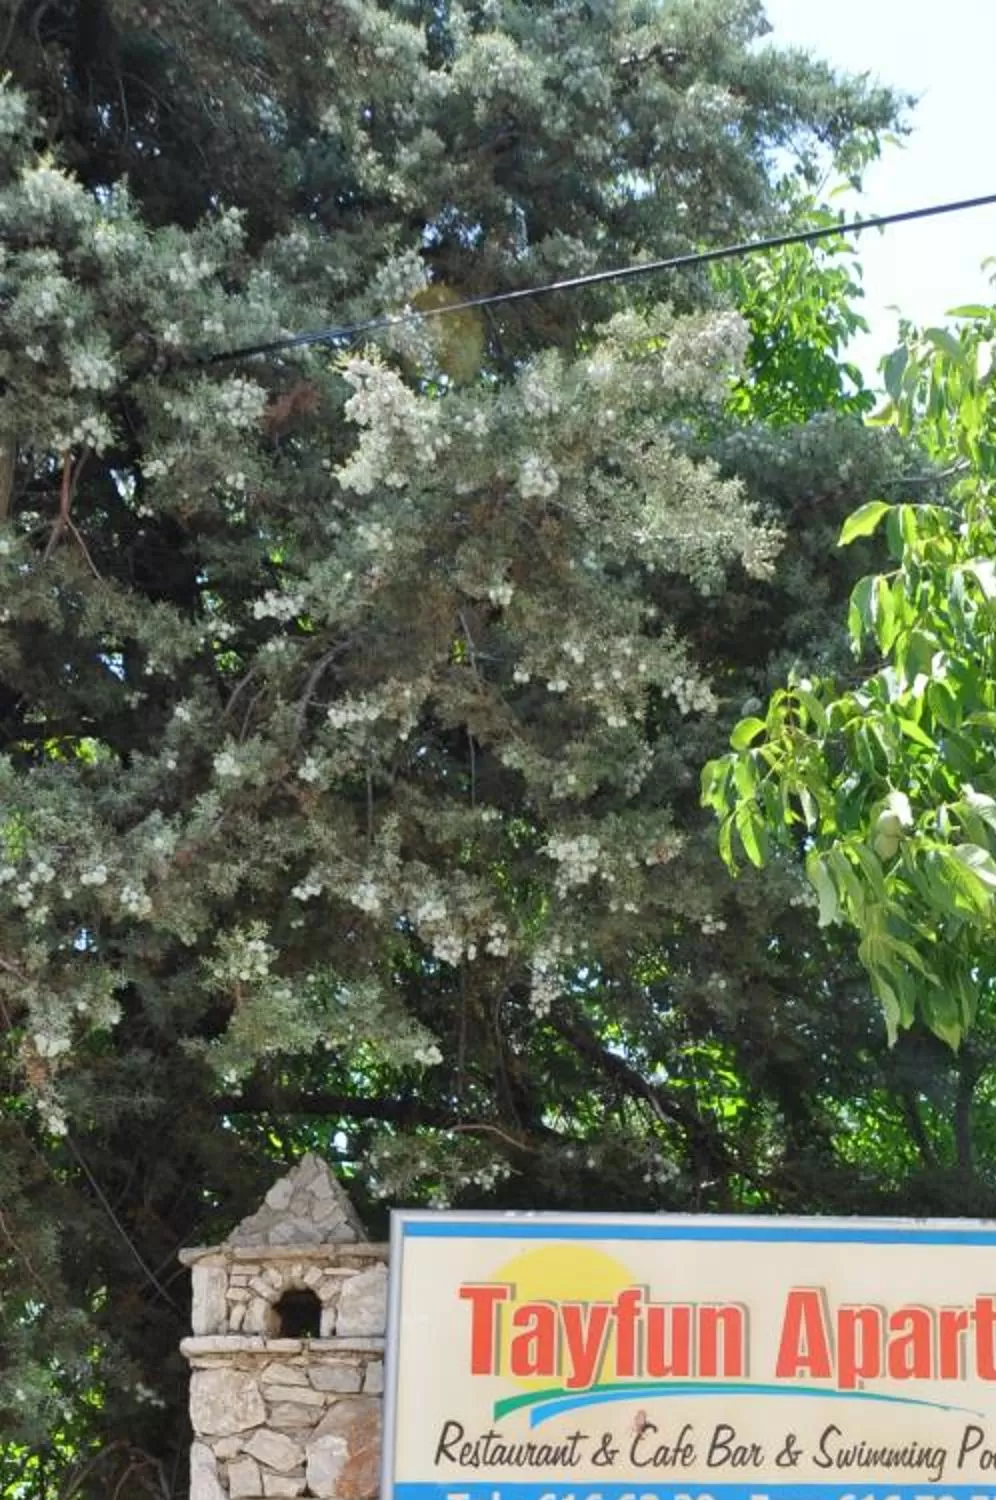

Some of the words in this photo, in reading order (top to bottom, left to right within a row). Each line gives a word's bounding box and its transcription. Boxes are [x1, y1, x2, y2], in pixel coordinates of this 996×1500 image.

[459, 1282, 749, 1388] Tayfun
[434, 1419, 589, 1468] Restaurant
[591, 1432, 620, 1468] &
[629, 1422, 697, 1468] Cafe
[707, 1423, 764, 1468] Bar
[775, 1433, 803, 1468] &
[812, 1424, 947, 1482] Swimming
